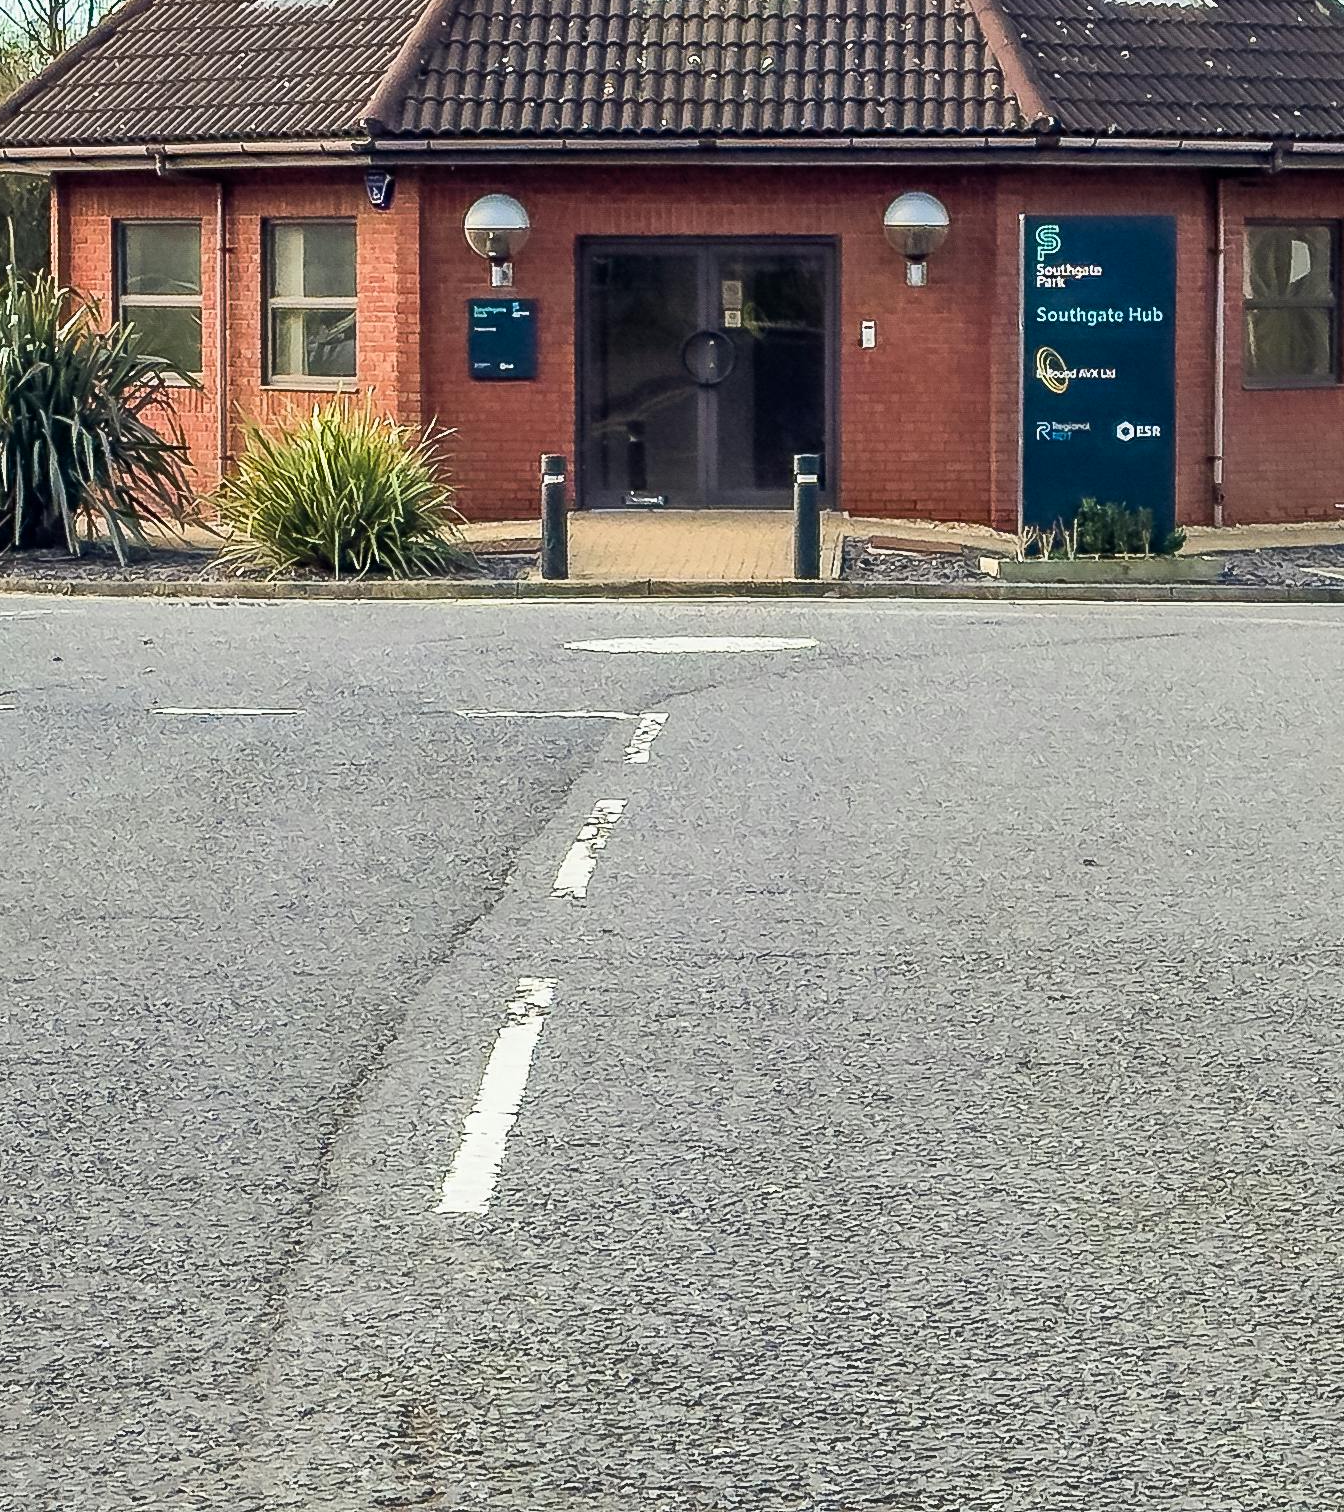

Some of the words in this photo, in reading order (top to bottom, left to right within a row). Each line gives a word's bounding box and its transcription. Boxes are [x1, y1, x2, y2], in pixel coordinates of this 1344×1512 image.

[1036, 264, 1102, 279] Southgate
[1036, 276, 1065, 288] Park
[1036, 307, 1124, 326] Southgate
[1129, 307, 1163, 322] Hub
[1101, 369, 1116, 378] Ltd
[1052, 422, 1090, 431] Regional
